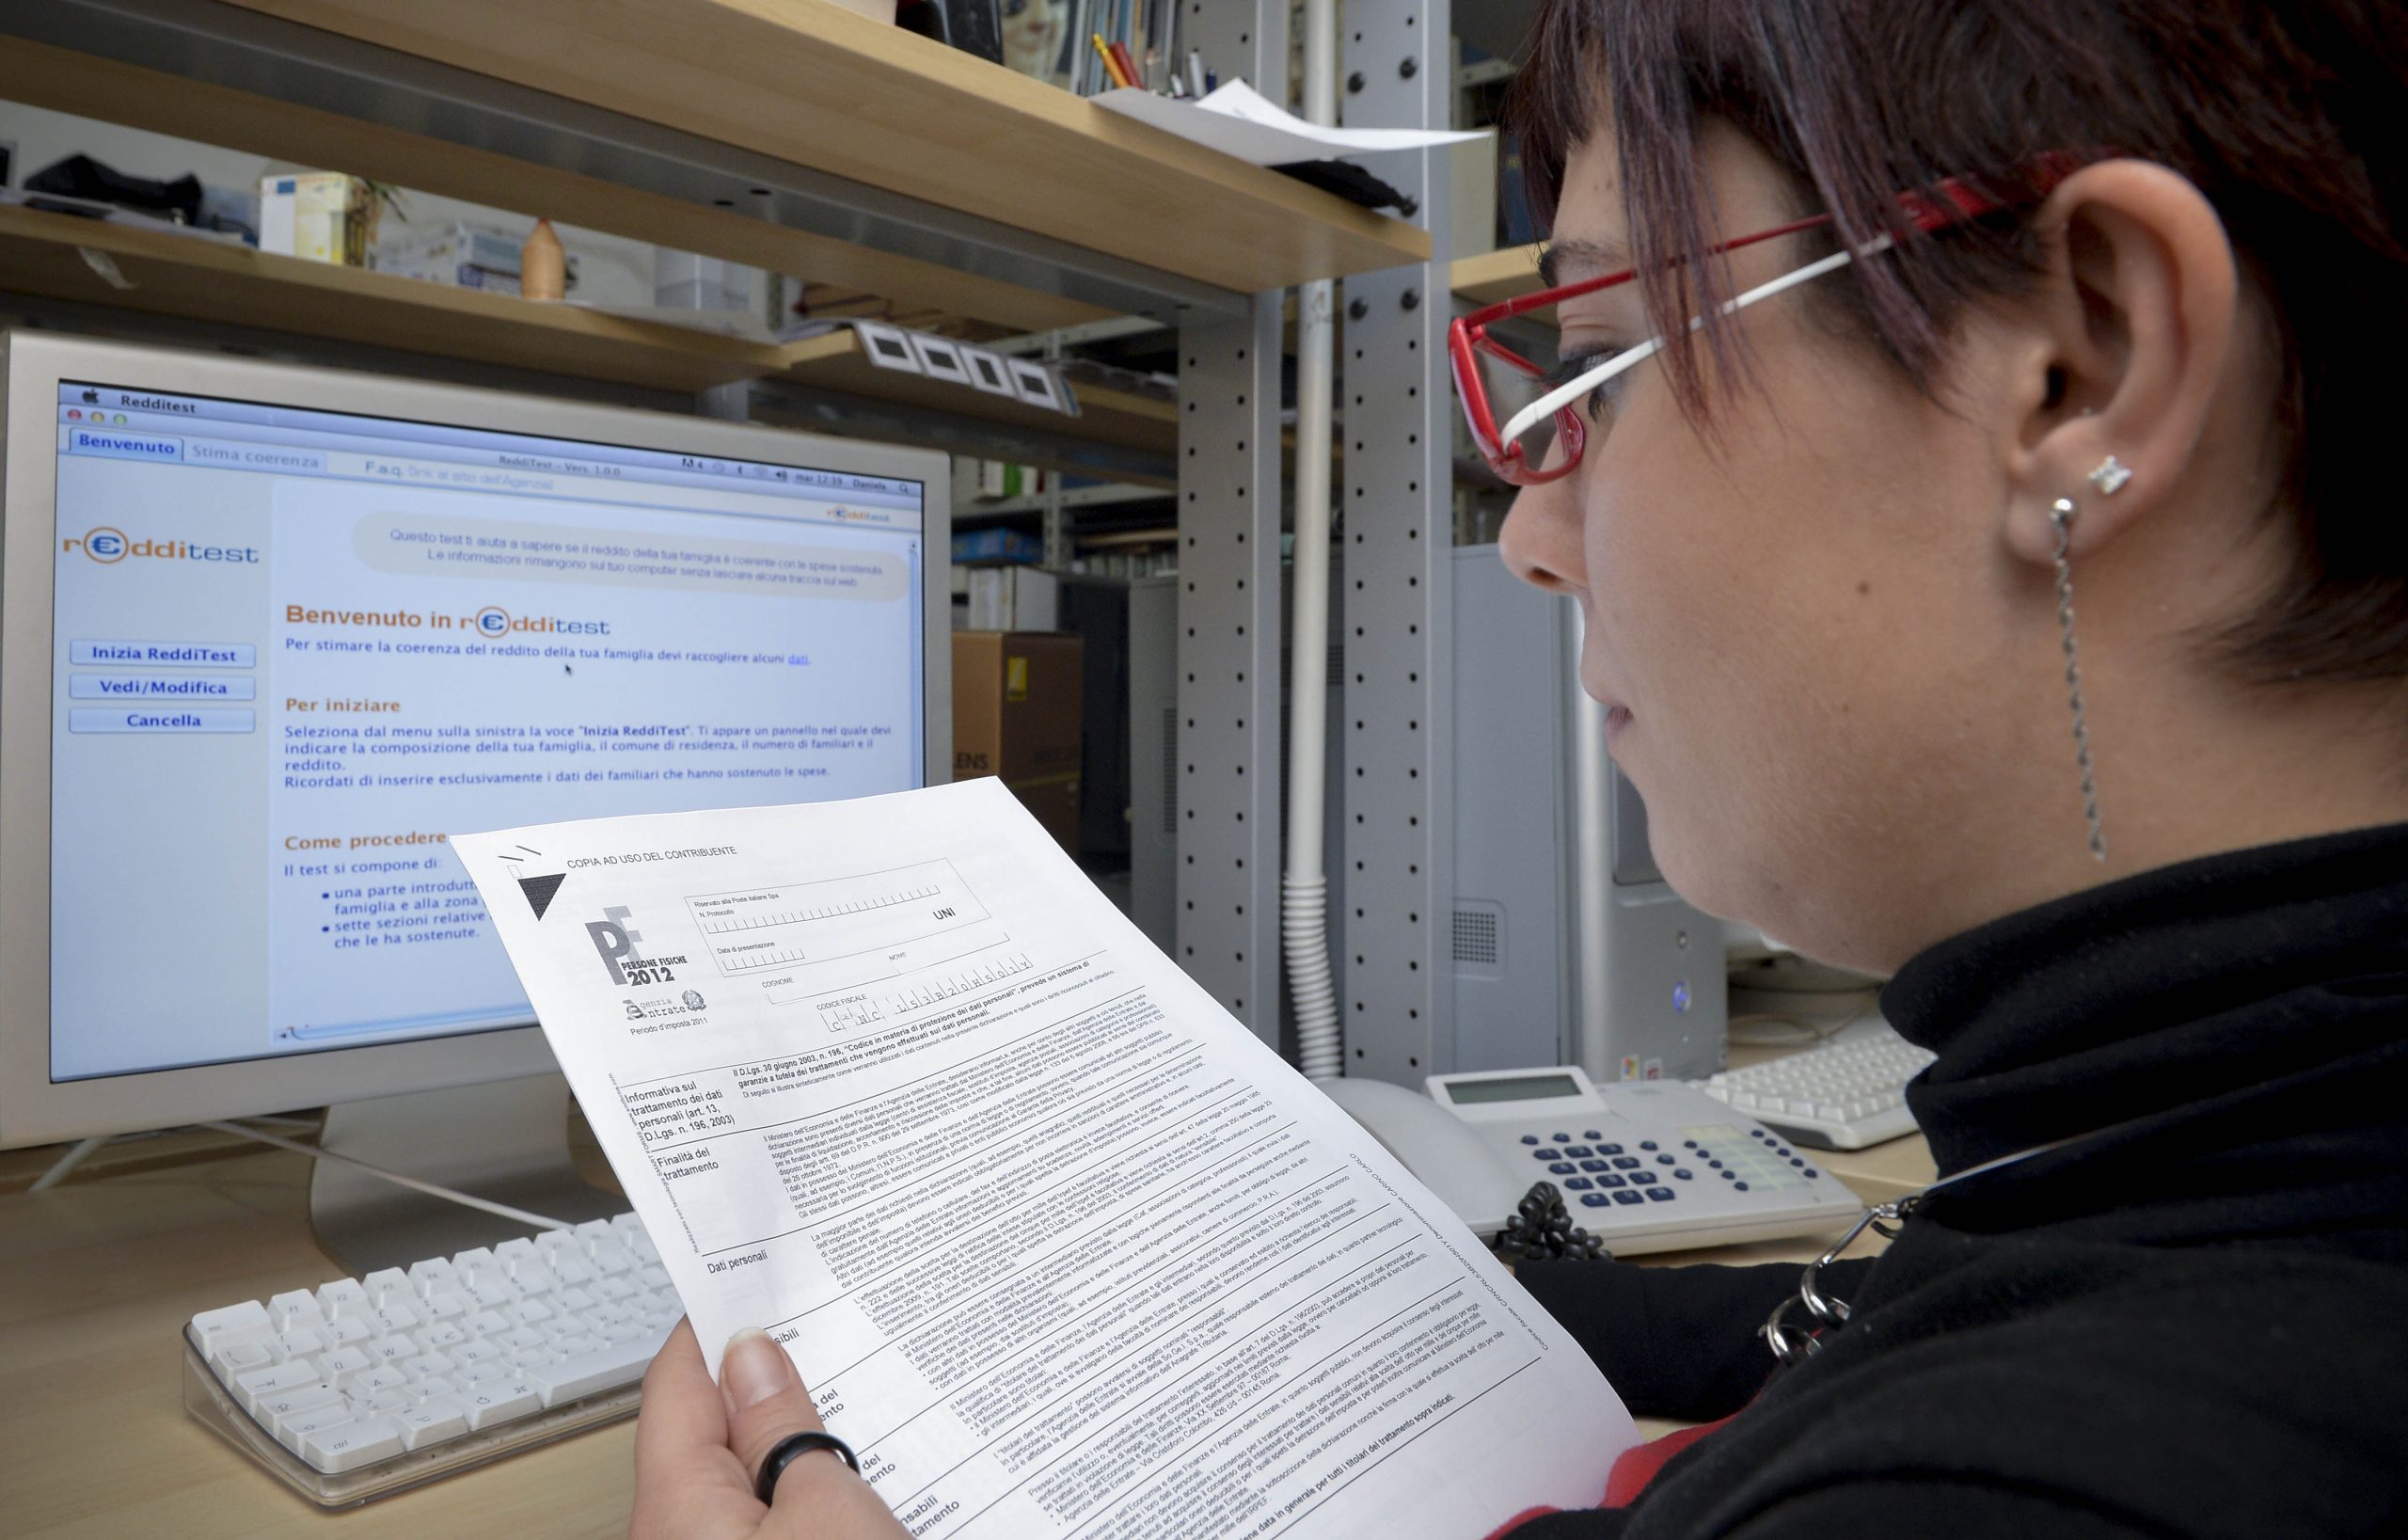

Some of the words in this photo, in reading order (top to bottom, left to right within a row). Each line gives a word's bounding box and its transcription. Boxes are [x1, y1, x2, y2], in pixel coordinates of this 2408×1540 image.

[120, 395, 196, 414] Redditest
[79, 434, 175, 455] Benvenuto
[192, 444, 240, 461] Stima
[245, 452, 319, 468] coerenza
[286, 605, 421, 627] Benvenuto
[431, 611, 451, 628] in
[92, 646, 141, 659] Inizia
[148, 647, 235, 661] ReddiTest
[285, 637, 309, 650] Per
[316, 641, 372, 652] stimare
[377, 641, 390, 653] la
[395, 643, 461, 655] coerenza
[465, 643, 486, 655] del
[491, 644, 540, 657] reddito
[544, 645, 576, 658] della
[579, 648, 599, 659] tua
[604, 647, 654, 662] famiglia
[657, 649, 681, 660] devi
[685, 651, 749, 664] raccogliere
[752, 653, 784, 663] alcuni
[787, 654, 812, 665] dati.
[100, 680, 227, 694] Vedi/Modifica
[286, 698, 318, 711] Per
[326, 698, 400, 712] iniziare
[126, 714, 201, 726] Cancella
[285, 725, 359, 738] Seleziona
[363, 725, 386, 738] dal
[391, 728, 432, 738] menu
[437, 725, 470, 738] sulla
[475, 727, 525, 737] sinistra
[530, 725, 541, 737] la
[545, 727, 575, 737] voce
[698, 725, 708, 735] Ti
[712, 727, 751, 738] appare
[754, 727, 768, 736] un
[771, 725, 818, 738] pannello
[821, 725, 837, 735] nel
[840, 725, 867, 737] quale
[871, 725, 891, 735] devi
[285, 741, 347, 754] indicare
[352, 741, 365, 754] la
[371, 742, 471, 755] composizione
[475, 740, 509, 753] della
[513, 742, 534, 753] tua
[538, 740, 595, 754] famiglia,
[599, 740, 608, 751] il
[611, 742, 659, 752] comune
[663, 739, 674, 751] di
[678, 739, 737, 750] residenza,
[741, 739, 749, 749] il
[752, 741, 795, 750] numero
[798, 739, 808, 749] di
[811, 738, 854, 749] familiari
[866, 738, 873, 747] il
[285, 759, 345, 771] reddito.
[953, 752, 989, 770] ENS
[284, 775, 354, 788] Ricordati
[358, 774, 372, 786] di
[378, 775, 434, 786] inserire
[438, 772, 543, 785] esclusivamente
[547, 772, 551, 782] i
[555, 770, 579, 783] dati
[584, 770, 603, 782] dei
[608, 770, 659, 781] familiari
[662, 769, 683, 780] che
[687, 769, 723, 779] hanno
[727, 769, 781, 778] sostenuto
[784, 767, 794, 776] le
[798, 768, 830, 778] spese.
[285, 836, 341, 850] Come
[350, 831, 446, 850] procedere
[284, 865, 293, 876] Il
[299, 865, 327, 876] test
[334, 863, 345, 874] si
[351, 861, 419, 873] compone
[423, 857, 441, 869] di:
[566, 857, 602, 868] COPIA
[603, 855, 617, 865] AD
[618, 853, 642, 864] USO
[642, 851, 664, 861] DEL
[664, 846, 737, 860] CONTRIBUENTE
[334, 888, 362, 899] una
[367, 885, 405, 898] parte
[411, 881, 477, 894] introdutt
[334, 900, 396, 915] famiglia
[401, 901, 408, 911] e
[413, 897, 439, 910] alla
[444, 897, 478, 908] zona
[933, 907, 956, 921] UNI
[335, 920, 371, 932] sette
[376, 914, 428, 929] sezioni
[433, 912, 485, 925] relative
[334, 936, 360, 948] che
[365, 934, 378, 945] le
[384, 933, 402, 945] ha
[406, 928, 479, 943] sostenute.
[621, 959, 658, 971] PERSONE
[658, 955, 688, 966] FISICHE
[626, 966, 675, 986] 2012
[762, 976, 794, 989] COGNOME
[816, 999, 841, 1010] CODICE
[840, 993, 867, 1005] FISCALE
[629, 1024, 657, 1035] Periodo
[658, 1020, 691, 1030] d'imposta
[690, 1017, 707, 1025] 2011
[737, 1075, 768, 1089] garanzie
[774, 1071, 796, 1081] tutela
[796, 1067, 808, 1076] dei
[808, 1056, 848, 1073] trattamenti
[863, 1043, 895, 1057] vengono
[896, 1030, 928, 1047] effettuati
[929, 1026, 941, 1036] sui
[942, 1021, 956, 1031] dati
[956, 1008, 990, 1027] personali.
[624, 1086, 681, 1103] Informativa
[681, 1080, 697, 1091] sul
[630, 1097, 688, 1116] trattamento
[689, 1092, 705, 1103] dei
[705, 1088, 722, 1100] dati
[638, 1110, 684, 1131] personali
[685, 1106, 705, 1119] (art.
[705, 1103, 721, 1114] 13,
[643, 1129, 677, 1141] D.Lgs.
[689, 1119, 710, 1131] 196,
[709, 1114, 735, 1127] 2003)
[657, 1151, 694, 1167] Finalità
[694, 1147, 710, 1158] del
[663, 1161, 719, 1181] trattamento
[706, 1260, 727, 1274] Dati
[727, 1249, 768, 1271] personali
[1259, 1516, 1276, 1532] data
[1284, 1488, 1316, 1514] generale
[1315, 1478, 1328, 1491] per
[1326, 1466, 1343, 1480] tutti
[1345, 1449, 1370, 1468] titolari
[1368, 1439, 1380, 1453] del
[1379, 1420, 1415, 1445] trattamento
[1414, 1407, 1433, 1421] sopra
[1431, 1394, 1455, 1410] indicati.
